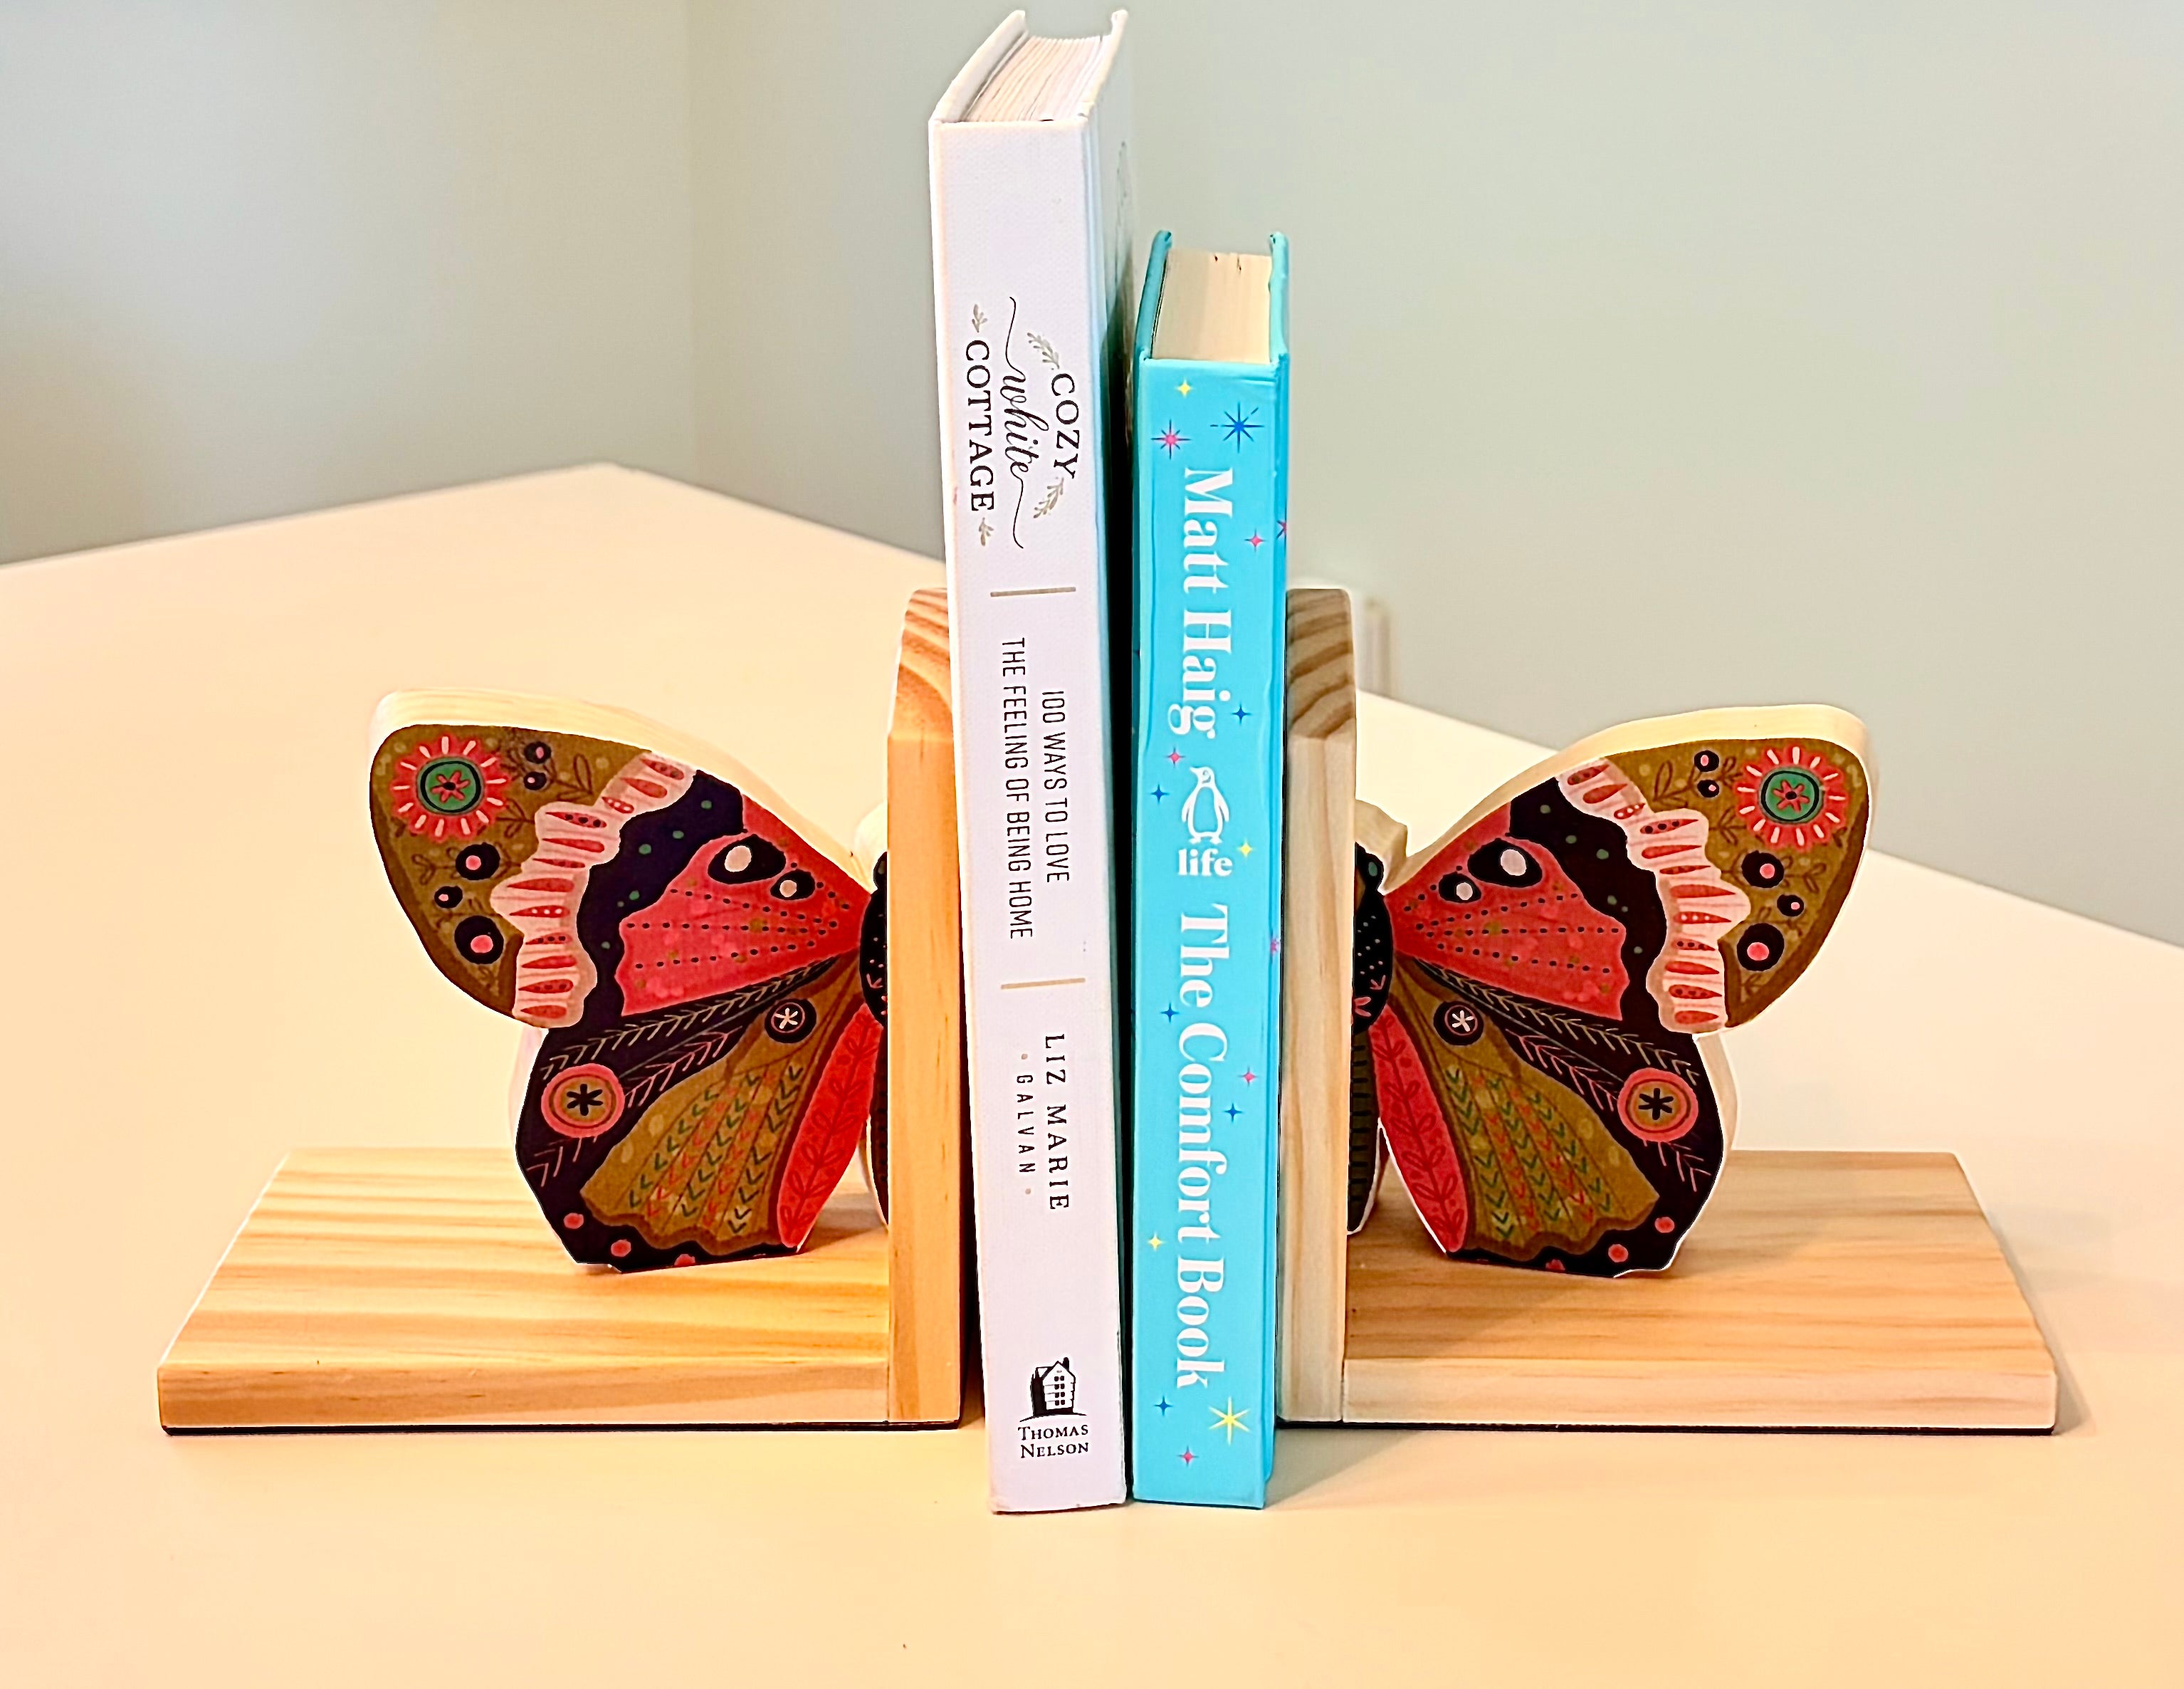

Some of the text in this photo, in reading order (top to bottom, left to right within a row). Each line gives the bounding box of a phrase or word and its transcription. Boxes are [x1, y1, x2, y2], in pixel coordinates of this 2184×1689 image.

[965, 340, 994, 511] COTTAGE
[1051, 372, 1080, 479] COZY
[1168, 468, 1233, 739] Matt Haig
[1002, 637, 1033, 939] THE FEELING OF BEING HOME
[1041, 691, 1070, 883] 100 WAYS TO LOVE
[1178, 848, 1233, 877] life
[1016, 1074, 1036, 1173] GALVAN
[1045, 1033, 1069, 1210] LIZ MARIE
[1177, 904, 1230, 1389] The Comfort Book
